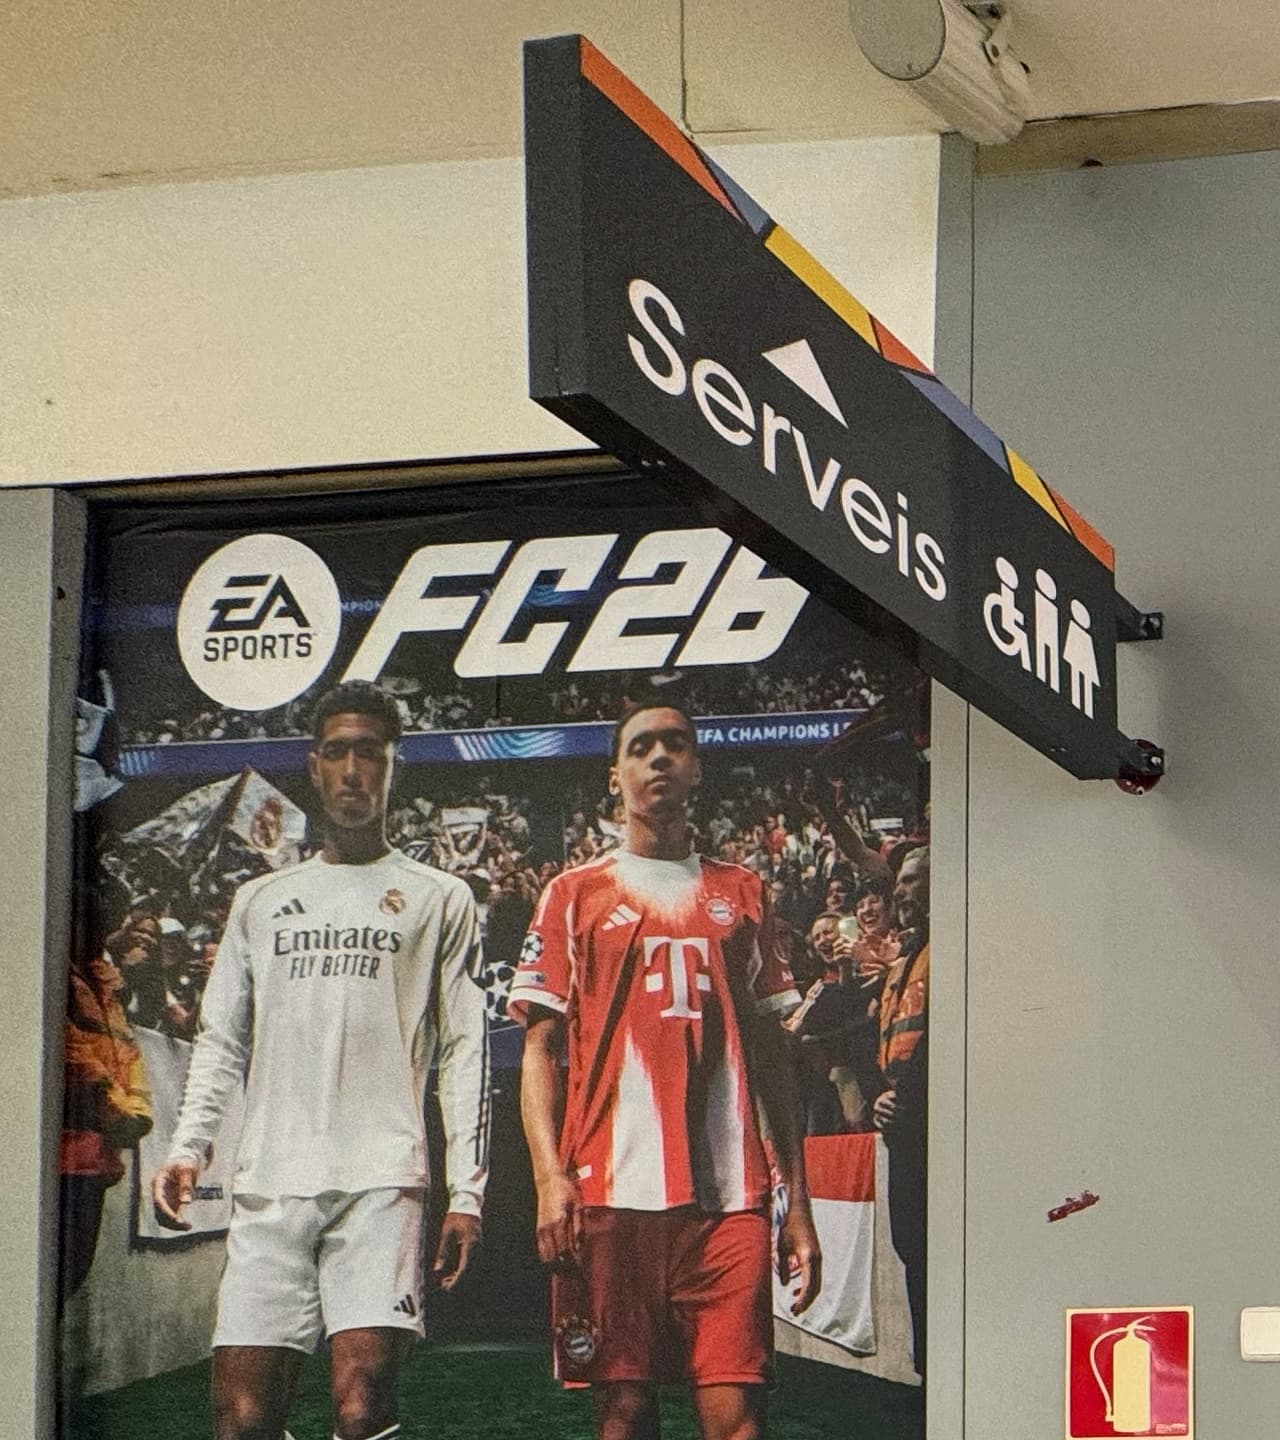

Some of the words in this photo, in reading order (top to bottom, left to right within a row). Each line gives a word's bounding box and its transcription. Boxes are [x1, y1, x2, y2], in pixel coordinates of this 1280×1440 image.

[626, 278, 947, 601] Serveis
[207, 573, 311, 632] EA
[341, 527, 811, 683] FC26
[203, 632, 314, 663] SPORTS
[727, 722, 831, 742] CHAMPIONS
[274, 922, 402, 955] Emirates
[289, 955, 317, 980] FLY
[321, 953, 381, 979] BETTER
[645, 936, 711, 1019] T
